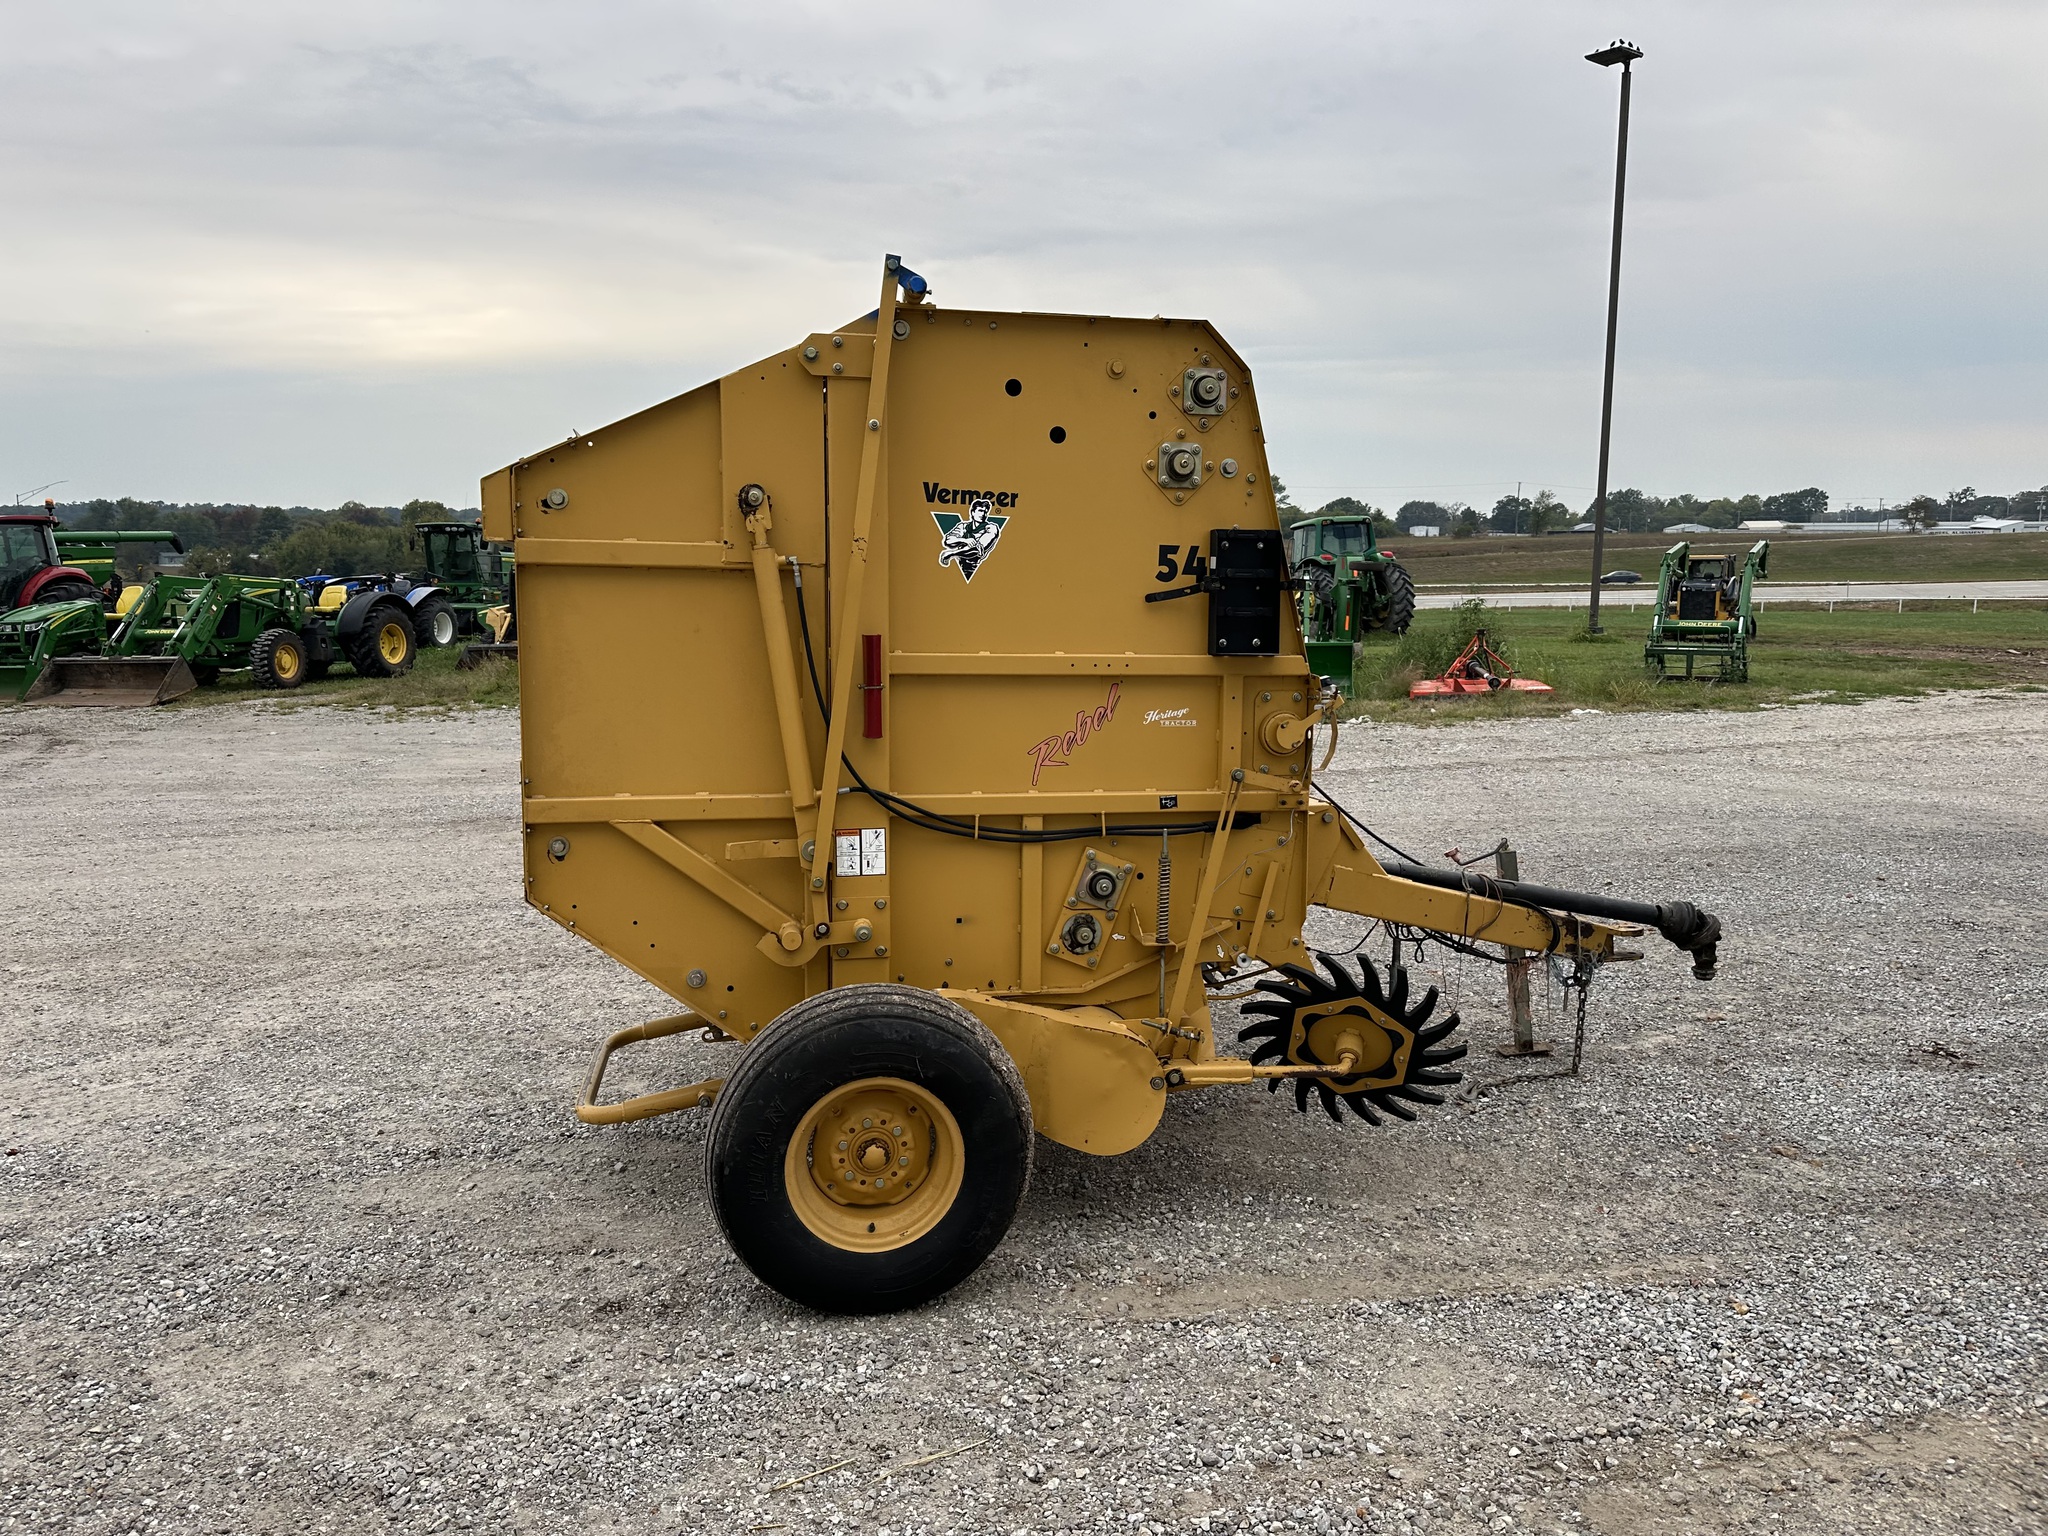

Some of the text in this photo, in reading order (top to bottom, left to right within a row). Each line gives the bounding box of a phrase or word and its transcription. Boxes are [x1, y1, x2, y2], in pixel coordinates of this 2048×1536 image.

[922, 481, 1019, 508] Vermeer
[1142, 707, 1190, 725] Heritage
[1160, 719, 1197, 727] TRACTOR
[1027, 682, 1121, 786] Rebel
